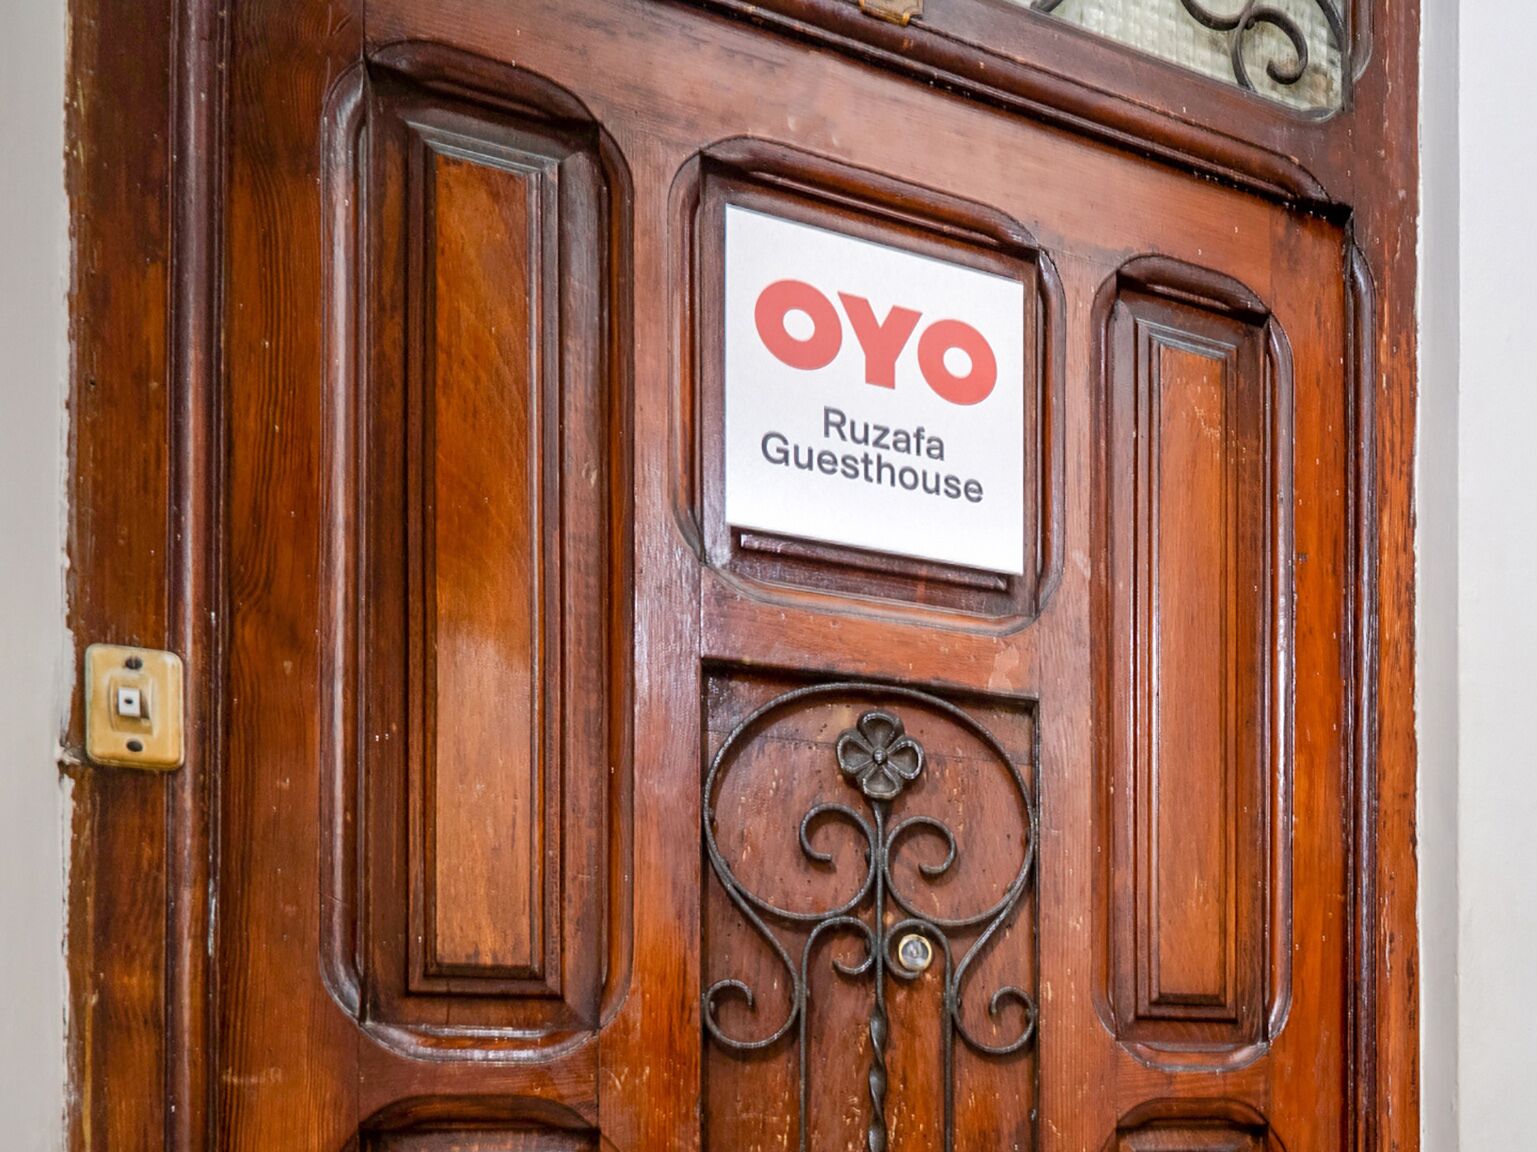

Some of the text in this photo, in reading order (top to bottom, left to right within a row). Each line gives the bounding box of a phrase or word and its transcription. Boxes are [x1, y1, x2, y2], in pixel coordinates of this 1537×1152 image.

[754, 279, 998, 406] OYO
[760, 431, 984, 504] Guesthouse
[822, 405, 946, 462] Ruzafa
